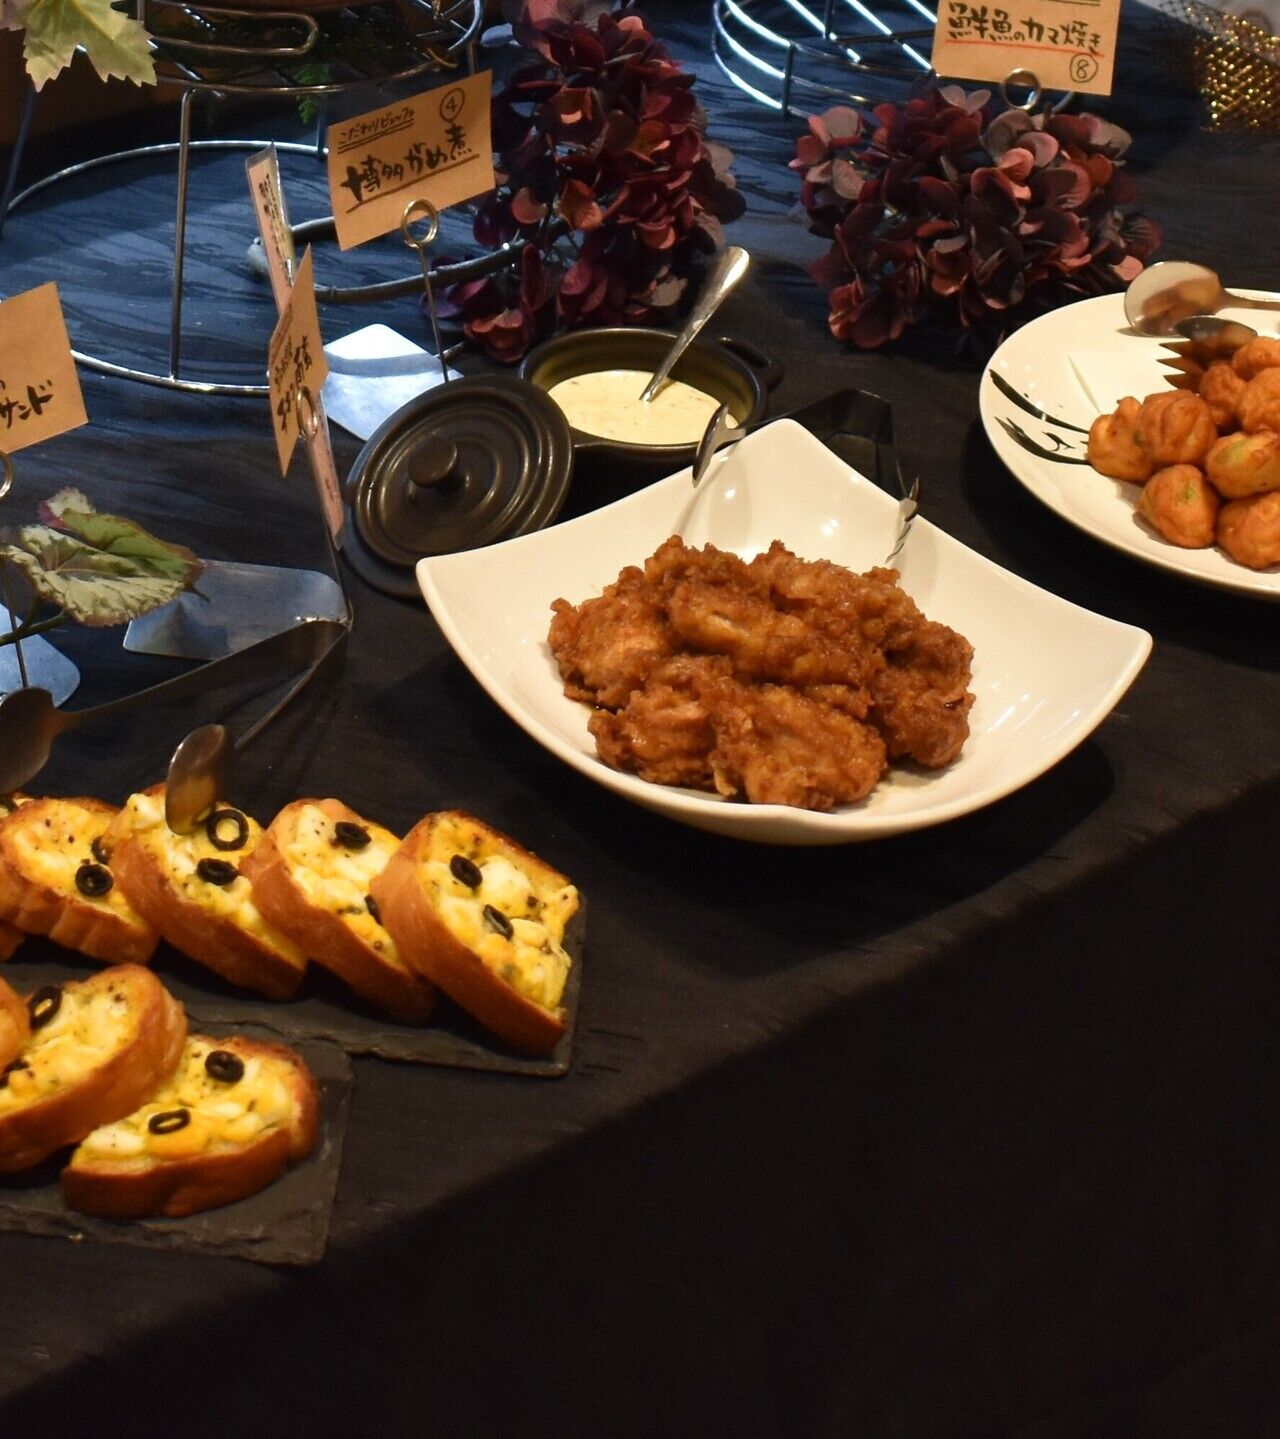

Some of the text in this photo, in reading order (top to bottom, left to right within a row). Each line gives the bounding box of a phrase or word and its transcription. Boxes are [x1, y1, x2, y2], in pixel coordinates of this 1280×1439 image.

[948, 1, 1104, 55] 鮮魚のカマ焼き
